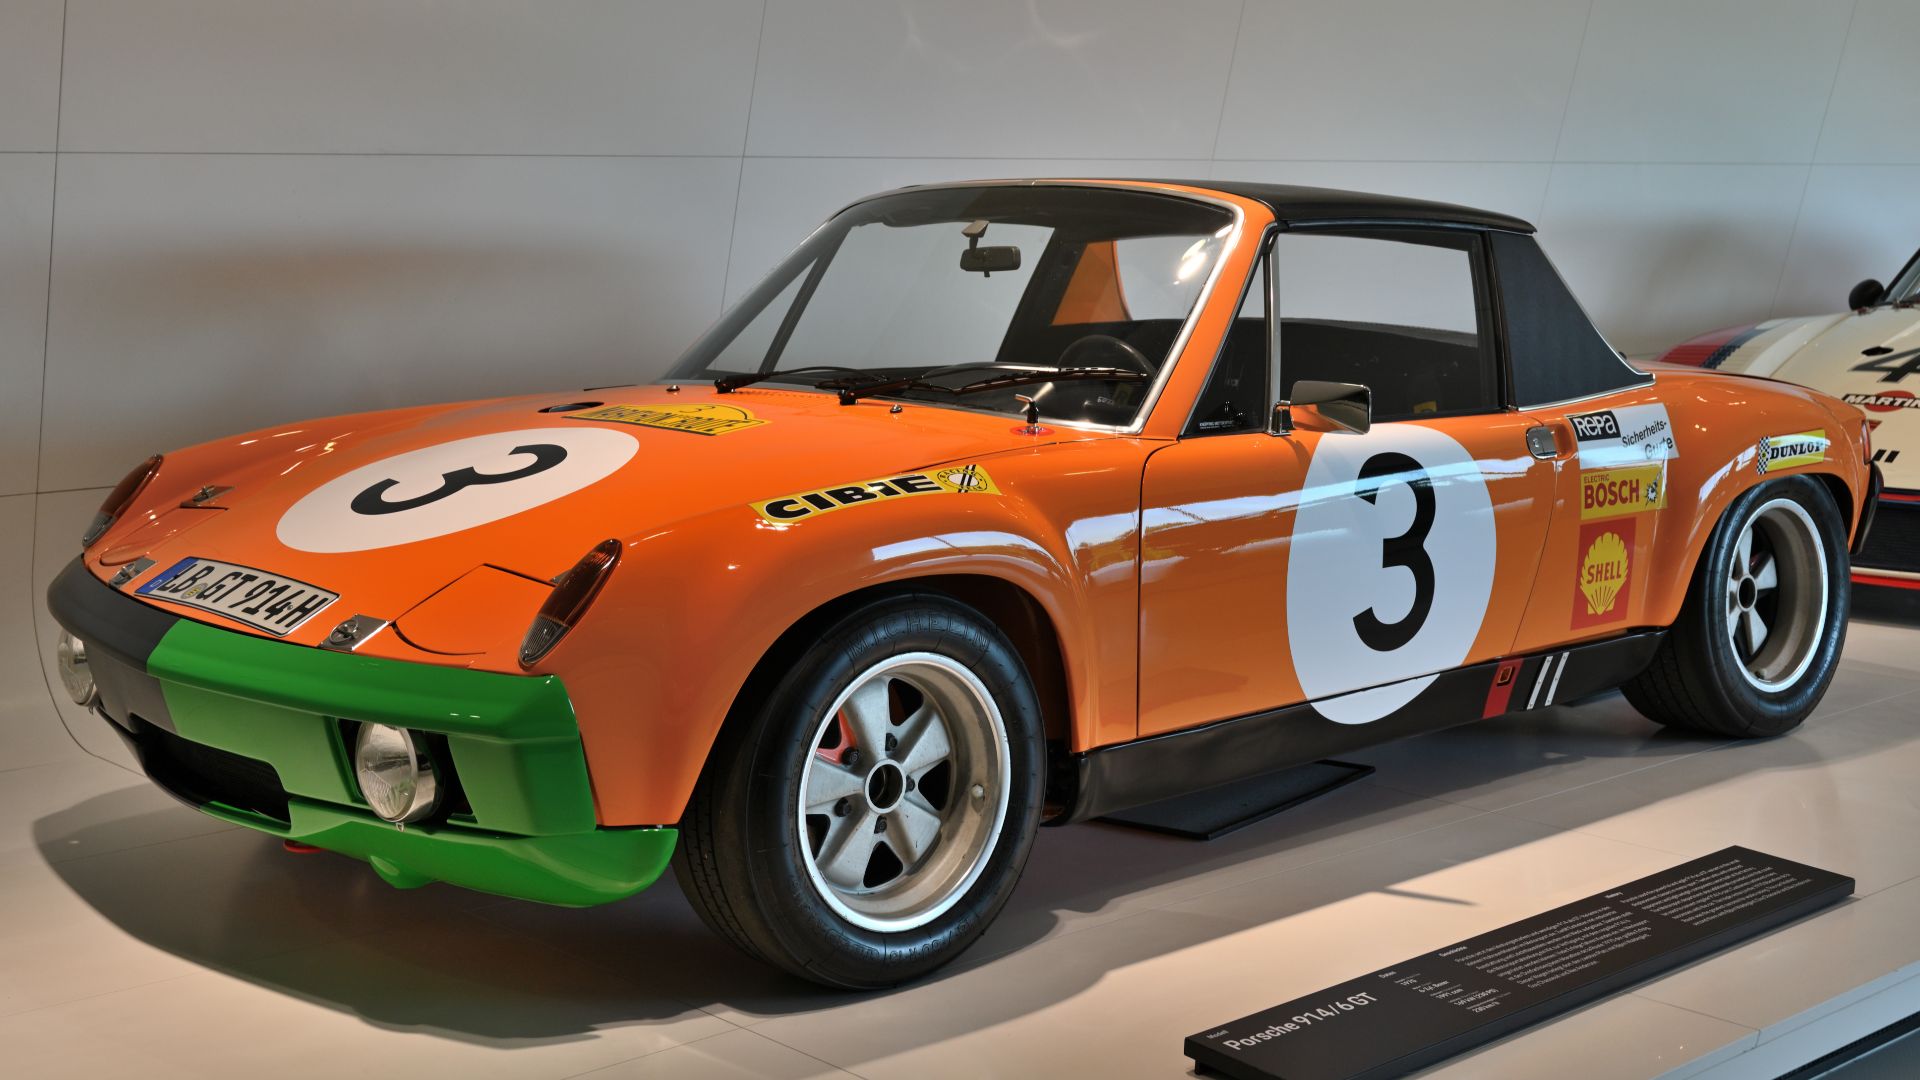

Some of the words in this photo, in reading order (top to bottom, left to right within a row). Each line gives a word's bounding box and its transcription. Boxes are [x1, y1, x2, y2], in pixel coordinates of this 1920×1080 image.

[1621, 420, 1667, 448] Sicherheits-
[351, 444, 567, 515] 3
[1583, 474, 1610, 484] ELECTRIC
[1584, 479, 1640, 510] BOSCH
[1353, 451, 1436, 652] 3
[157, 563, 215, 594] LB
[1586, 560, 1622, 584] SHELL
[1222, 1022, 1301, 1050] Porsche
[1291, 1001, 1355, 1025] 914/6
[1346, 991, 1378, 1006] GT
